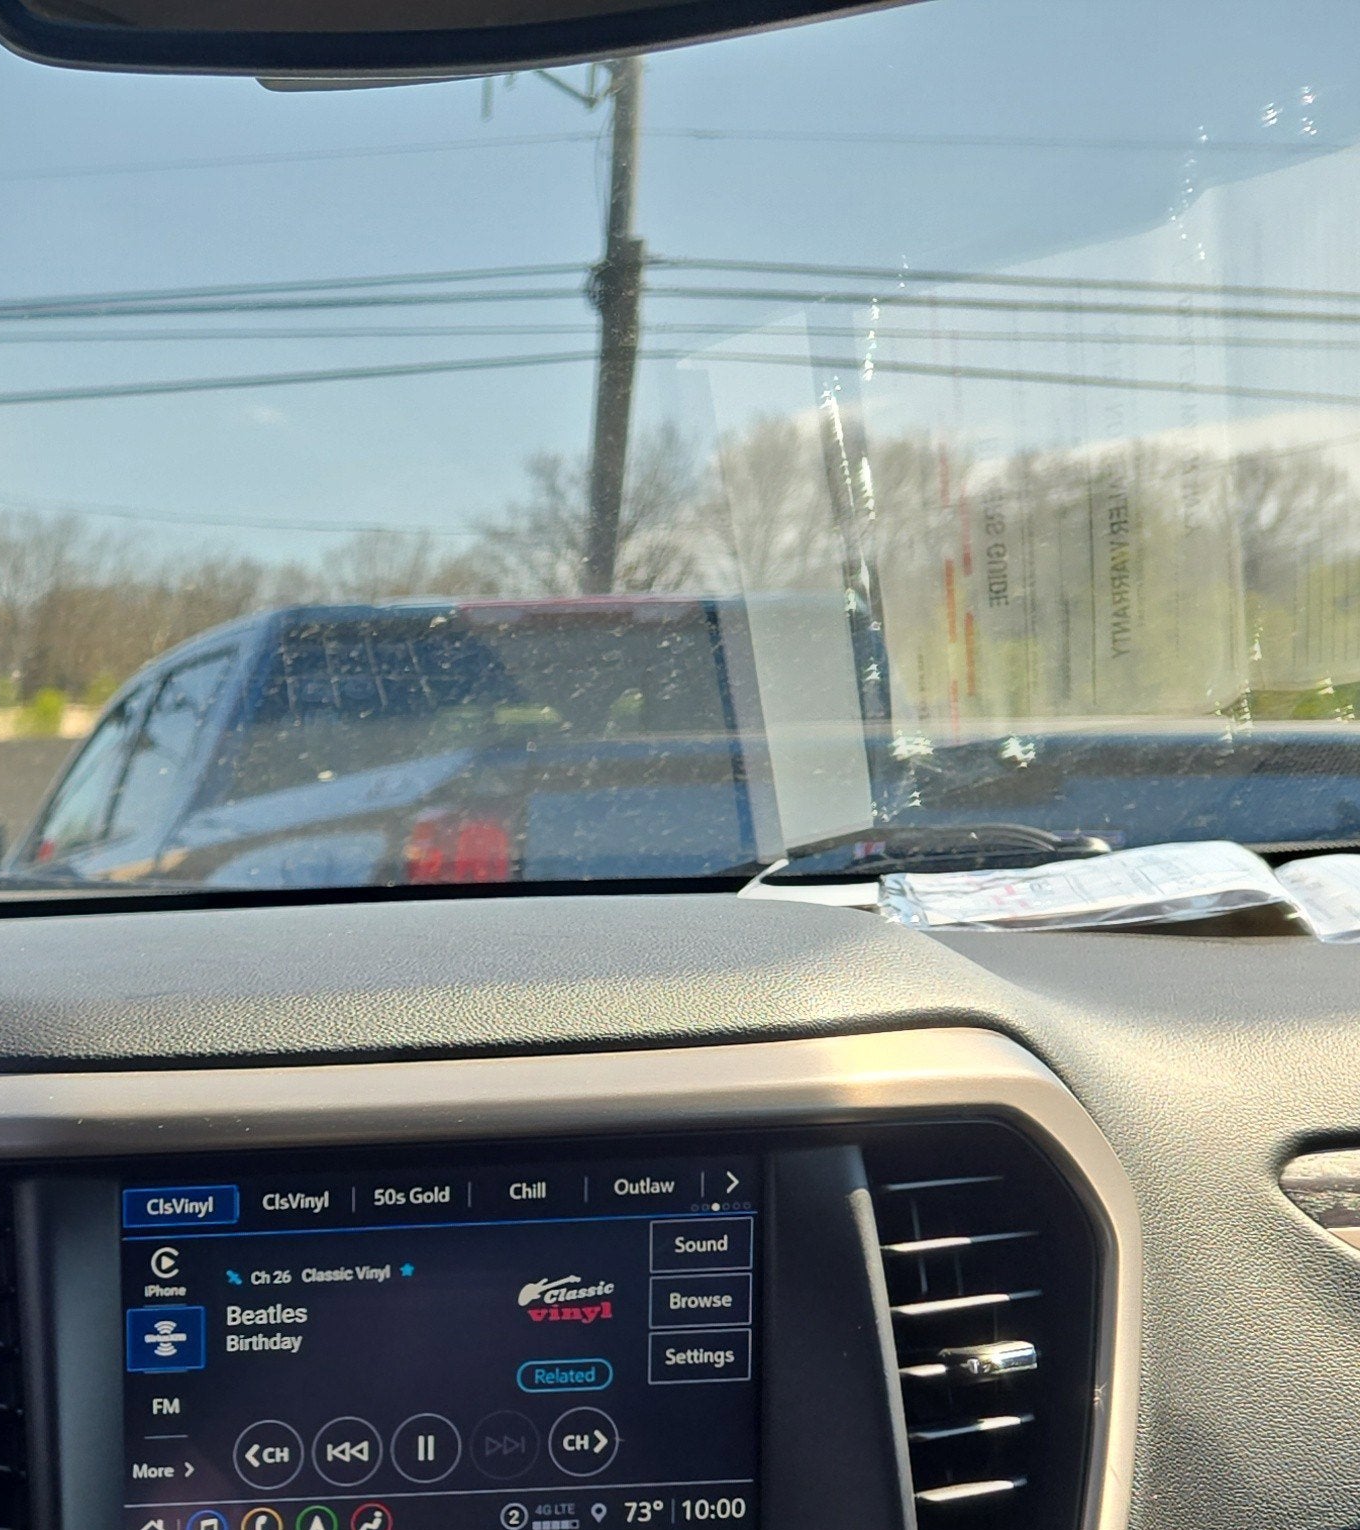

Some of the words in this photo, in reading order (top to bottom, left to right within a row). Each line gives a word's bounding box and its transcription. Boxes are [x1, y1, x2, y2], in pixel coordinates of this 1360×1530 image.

[373, 1188, 406, 1206] 50s
[409, 1186, 451, 1204] Gold
[509, 1182, 546, 1200] Chill
[614, 1178, 675, 1196] Outlaw
[146, 1197, 214, 1218] ClsVinyl
[262, 1191, 329, 1213] ClsVinyl
[674, 1235, 729, 1253] Sound
[251, 1271, 271, 1286] Ch
[273, 1270, 292, 1284] 26
[301, 1267, 353, 1283] Classic
[355, 1265, 391, 1281] Vinyl
[144, 1285, 187, 1298] iPhone
[543, 1281, 615, 1304] Classic
[669, 1293, 733, 1310] Browse
[226, 1304, 308, 1326] Beatles
[527, 1302, 613, 1324] vinyl
[226, 1333, 303, 1353] Birthday
[665, 1348, 735, 1368] Settings
[534, 1368, 596, 1384] Related
[152, 1398, 180, 1415] FM
[562, 1435, 589, 1451] CH
[262, 1447, 290, 1463] CH
[132, 1464, 174, 1479] More
[509, 1510, 520, 1525] 2
[534, 1504, 552, 1516] 4G
[555, 1503, 576, 1515] LTE
[624, 1501, 664, 1523] 73°
[682, 1498, 747, 1521] 10:00
